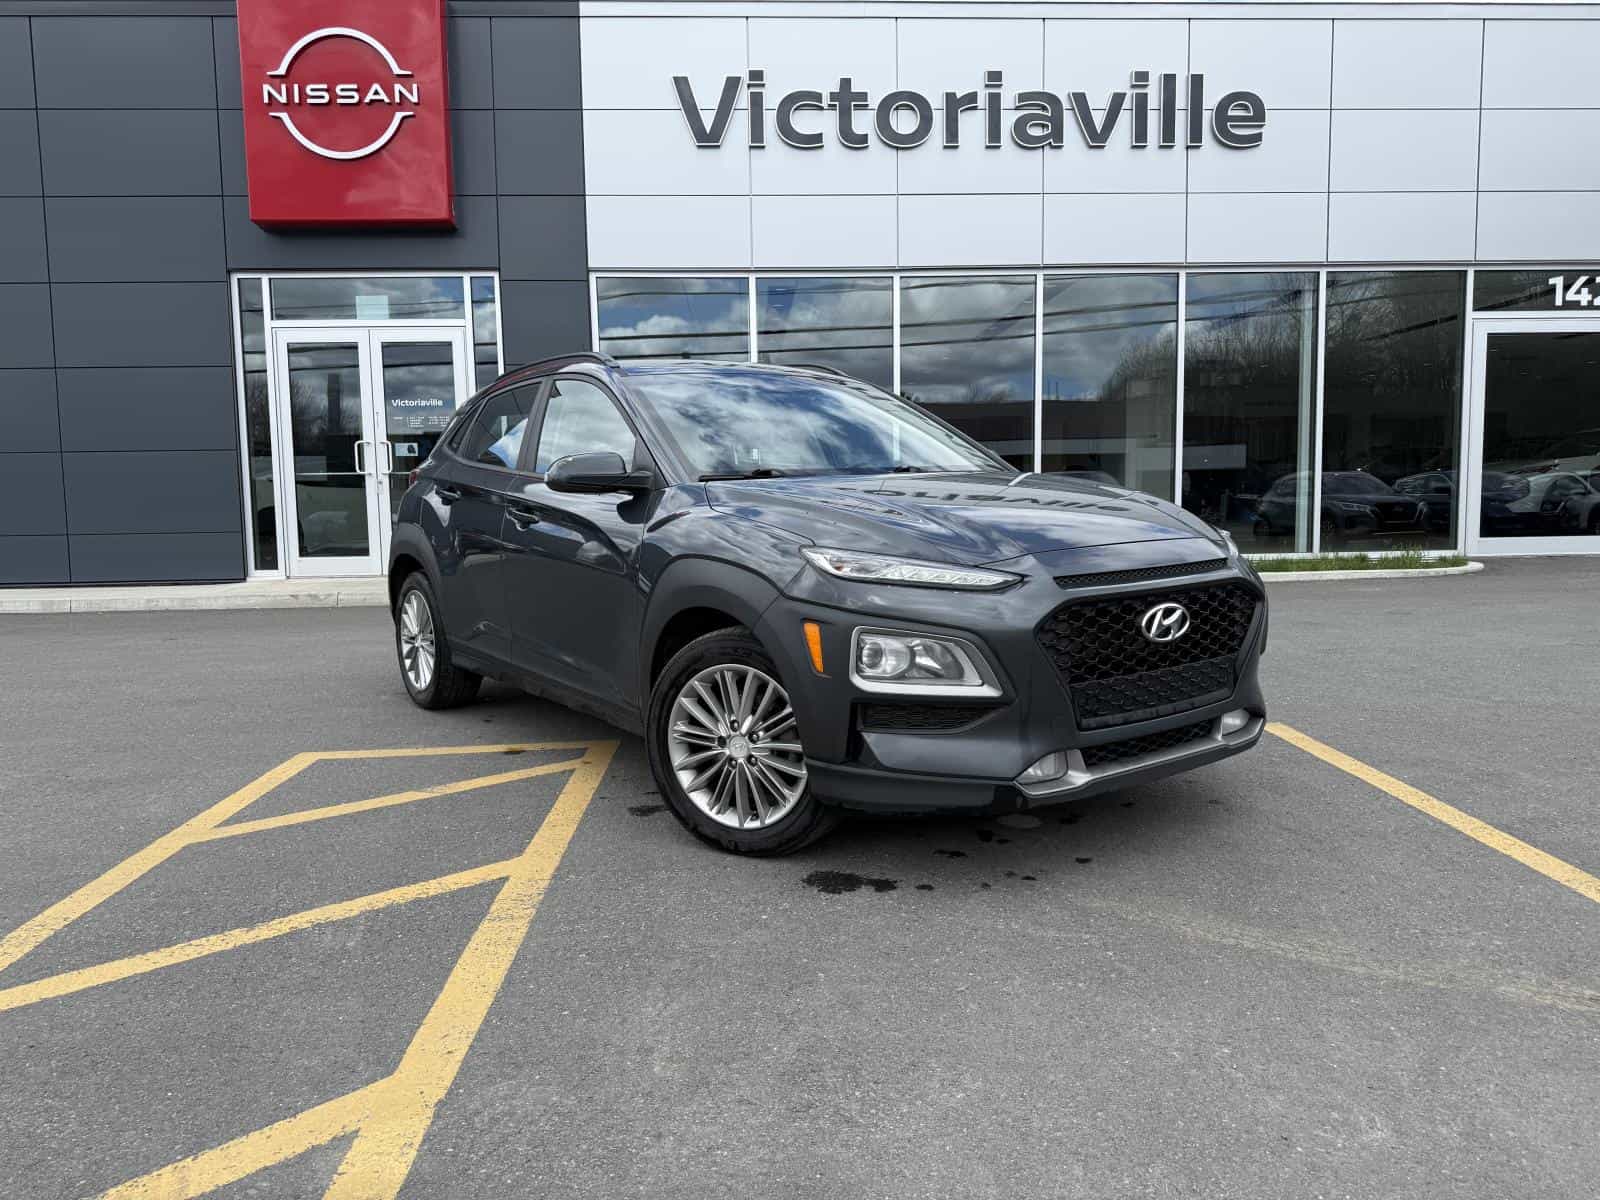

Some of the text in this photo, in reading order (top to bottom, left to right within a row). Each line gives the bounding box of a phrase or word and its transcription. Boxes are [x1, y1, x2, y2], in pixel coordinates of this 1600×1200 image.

[262, 83, 419, 104] NISSAN
[672, 69, 1266, 149] Victoriaville
[1548, 275, 1600, 306] 14
[391, 398, 443, 408] Victoriaville
